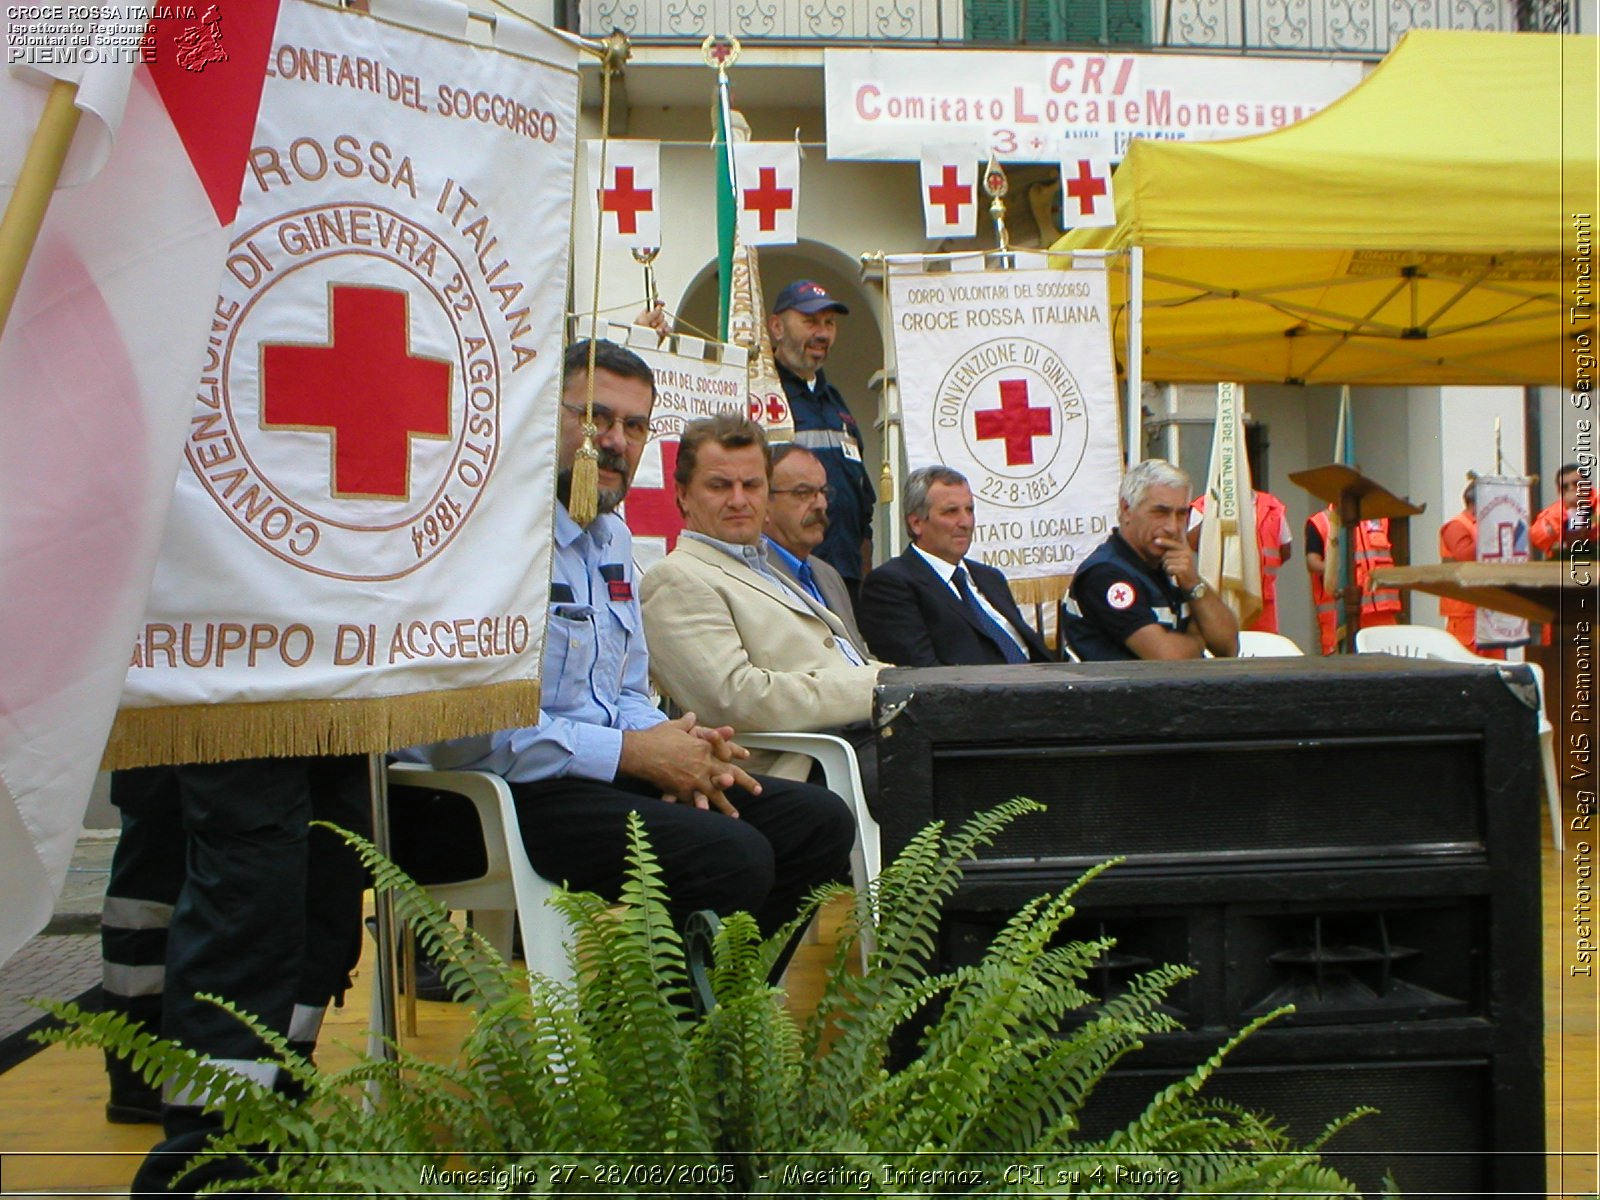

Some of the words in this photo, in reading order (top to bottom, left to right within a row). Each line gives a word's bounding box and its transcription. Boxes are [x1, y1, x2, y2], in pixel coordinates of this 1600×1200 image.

[264, 44, 381, 94] ONTARI
[386, 67, 428, 113] DEL
[437, 84, 557, 143] SOCCORSO
[1050, 57, 1135, 96] CRI
[856, 84, 1003, 122] Comitato
[992, 129, 1018, 154] 3
[226, 240, 274, 289] DI
[248, 135, 417, 199] ROSSA
[436, 178, 538, 374] ITALIANA
[278, 209, 437, 277] GINEVRA
[443, 272, 474, 320] 22
[908, 288, 945, 305] CORPO
[950, 285, 1009, 301] VOLONTARI
[1014, 284, 1033, 299] DEL
[1037, 282, 1090, 299] SOCCORSO
[902, 310, 960, 331] CROCE
[966, 307, 1025, 328] ROSSA
[1032, 305, 1101, 325] ITALIANA
[679, 373, 694, 392] DEL
[696, 377, 738, 397] SOCCORSO
[939, 343, 1016, 428] CONVENZIONE
[1024, 345, 1039, 365] DI
[1043, 355, 1082, 421] GINEVRA
[457, 336, 494, 488] AGOSTO
[1221, 408, 1233, 443] VERDE
[411, 493, 463, 559] 1864
[1030, 517, 1085, 538] LOCALE
[1091, 515, 1107, 534] DI
[983, 544, 1075, 567] MONESIGLIO
[333, 624, 377, 667] DI
[389, 614, 530, 665] ACCEGLIO
